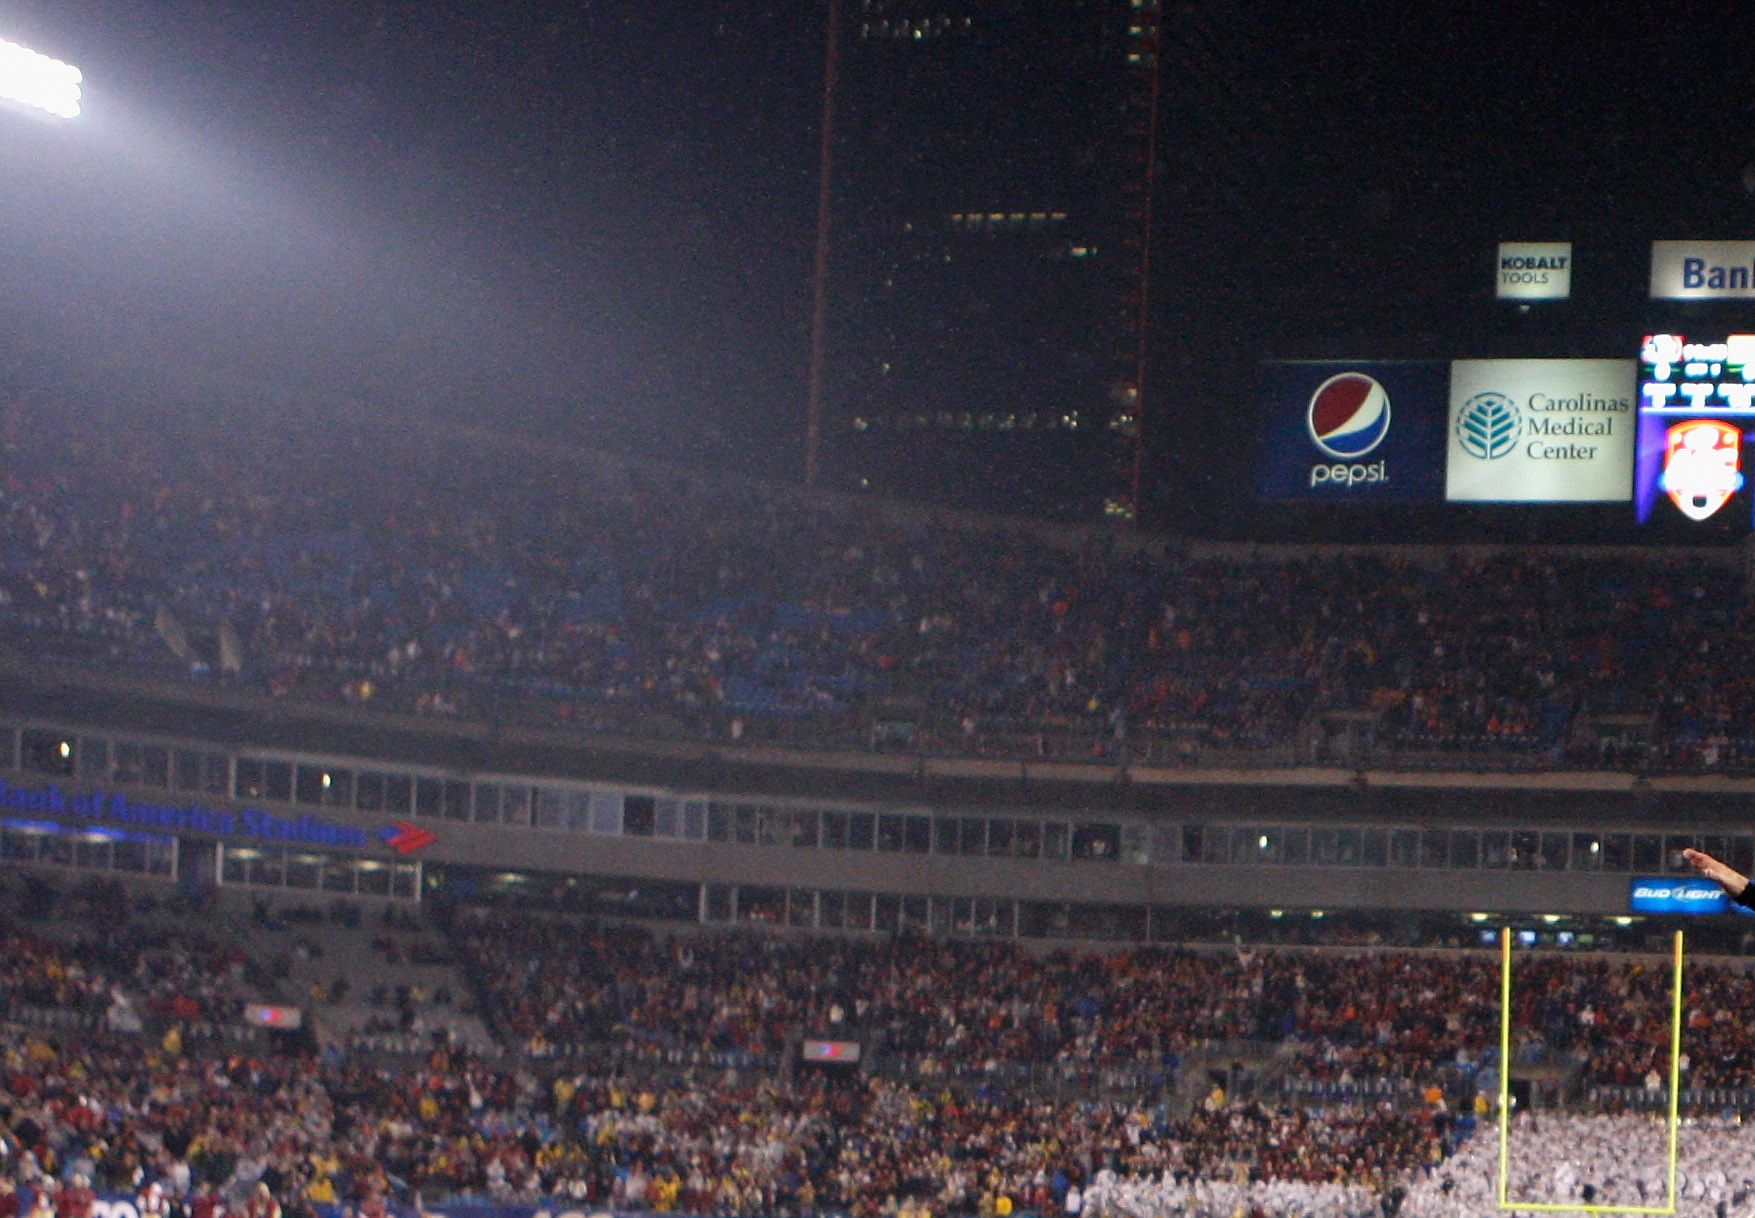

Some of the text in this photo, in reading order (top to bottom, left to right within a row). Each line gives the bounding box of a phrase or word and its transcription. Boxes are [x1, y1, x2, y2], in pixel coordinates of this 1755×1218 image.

[1501, 256, 1569, 270] KOBALT
[1502, 272, 1549, 284] TOOLS
[1528, 392, 1630, 413] Carolinas
[1527, 416, 1613, 436] Medical
[1526, 441, 1598, 460] Center
[1311, 460, 1385, 488] pepsi
[1676, 887, 1726, 900] LIGHT
